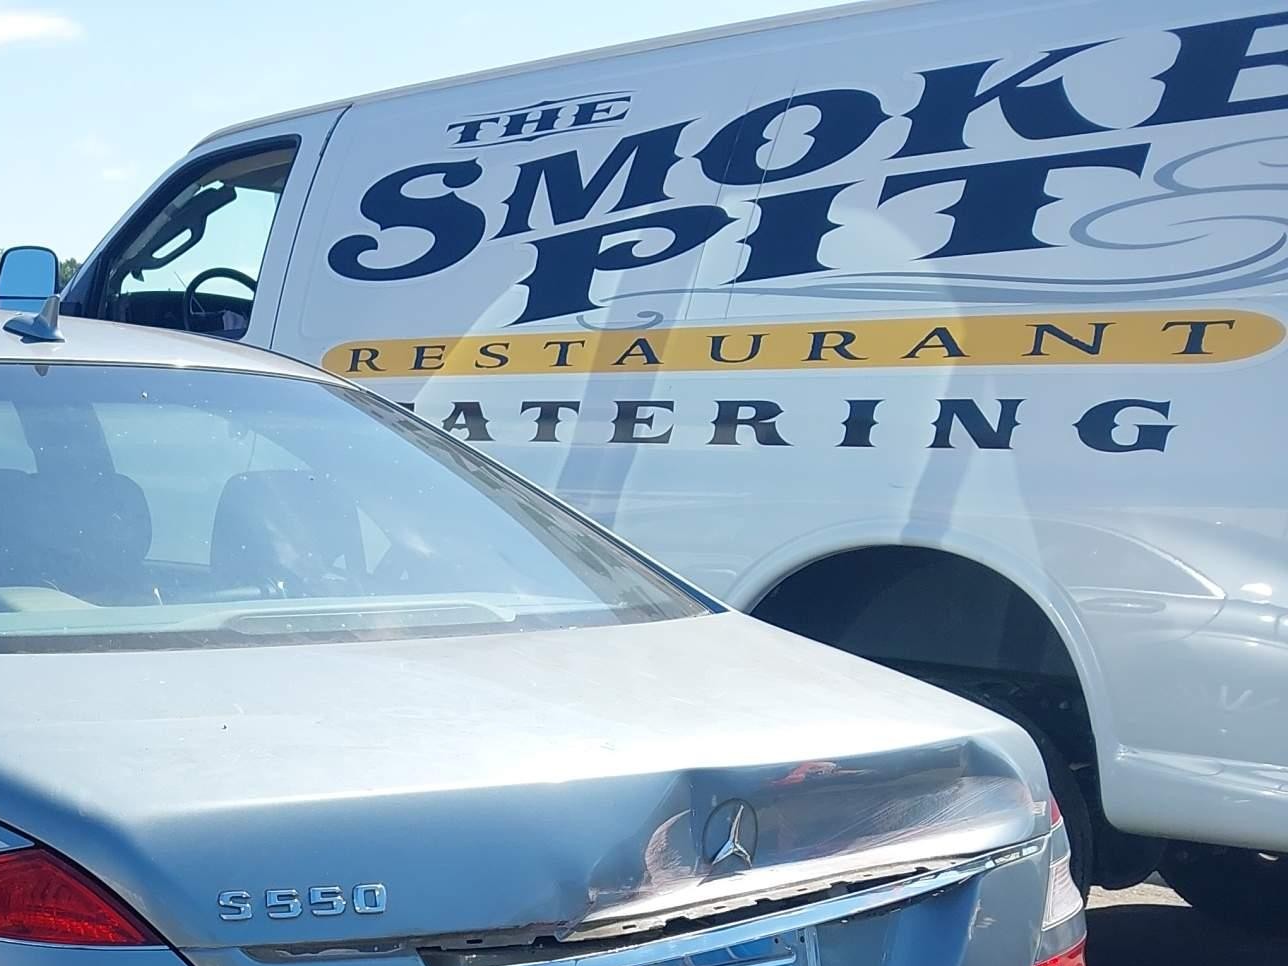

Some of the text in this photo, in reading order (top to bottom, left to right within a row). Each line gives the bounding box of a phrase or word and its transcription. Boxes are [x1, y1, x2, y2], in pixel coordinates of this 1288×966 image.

[327, 10, 1288, 282] SMOKE
[446, 95, 632, 145] THE
[502, 142, 1152, 328] PIT
[345, 318, 1236, 373] RESTAURANT
[396, 398, 1178, 453] ATERING
